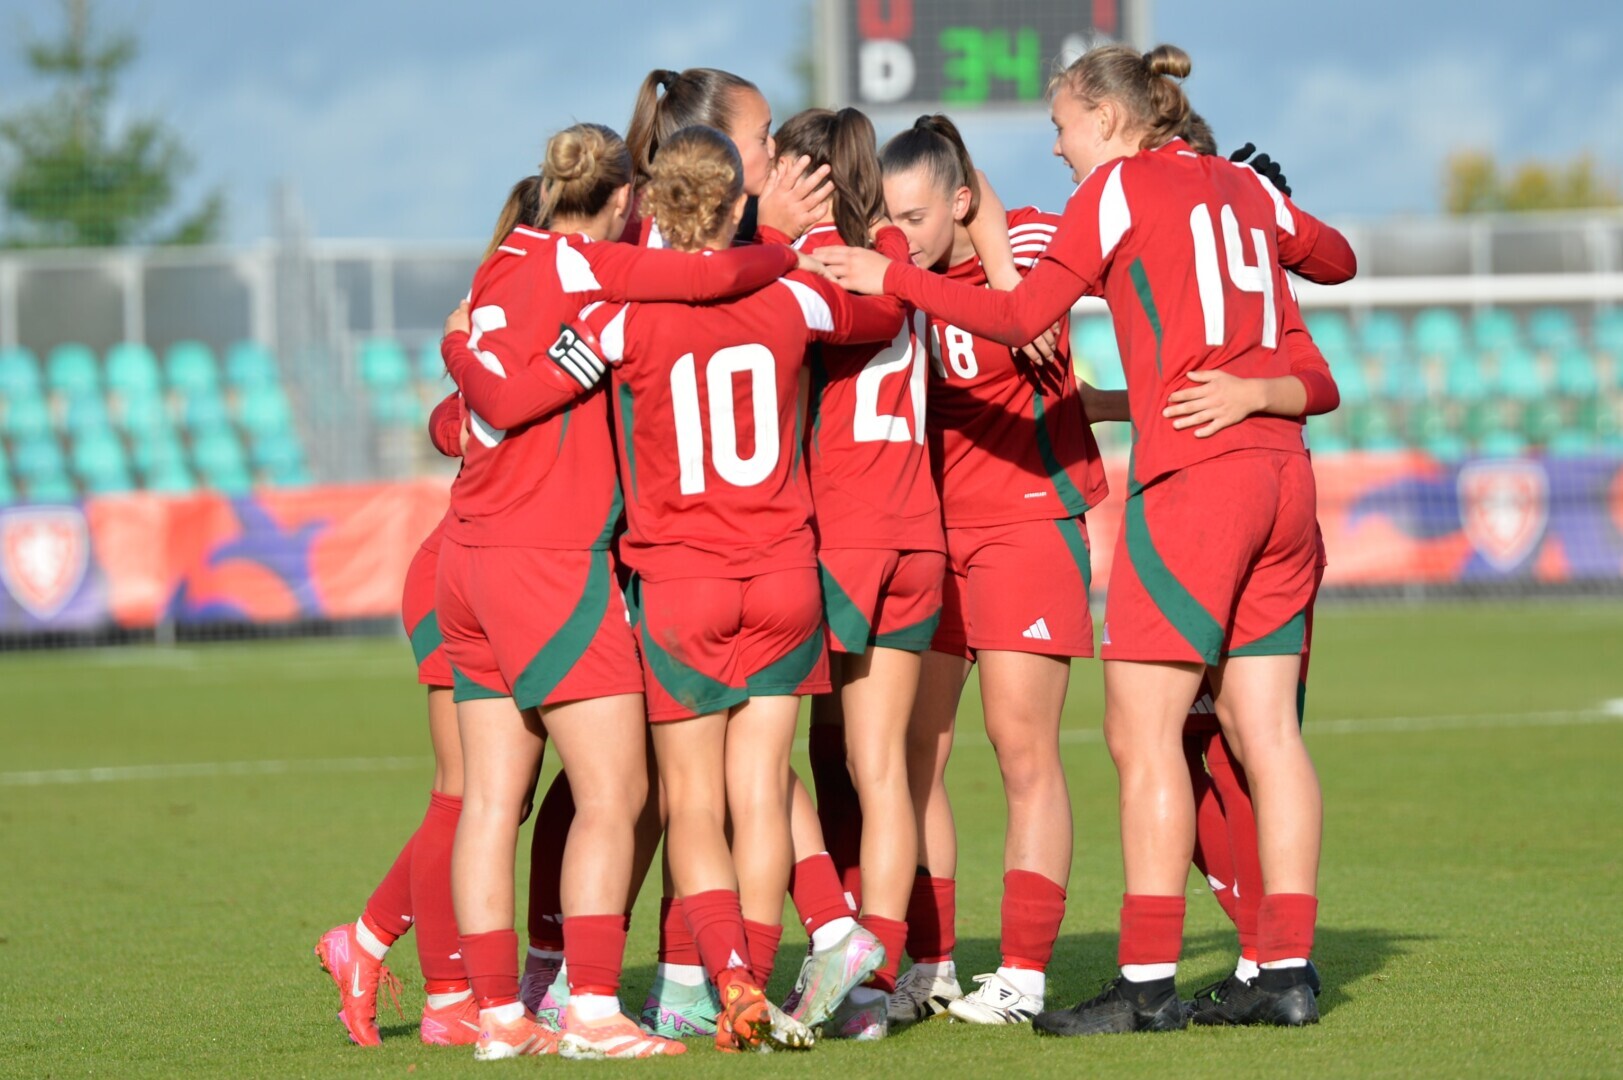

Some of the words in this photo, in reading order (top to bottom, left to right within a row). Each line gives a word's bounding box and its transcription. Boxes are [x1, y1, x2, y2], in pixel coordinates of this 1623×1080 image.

[938, 26, 1041, 108] 34
[1190, 203, 1276, 349] 14
[670, 343, 780, 495] 10
[853, 309, 927, 445] 21
